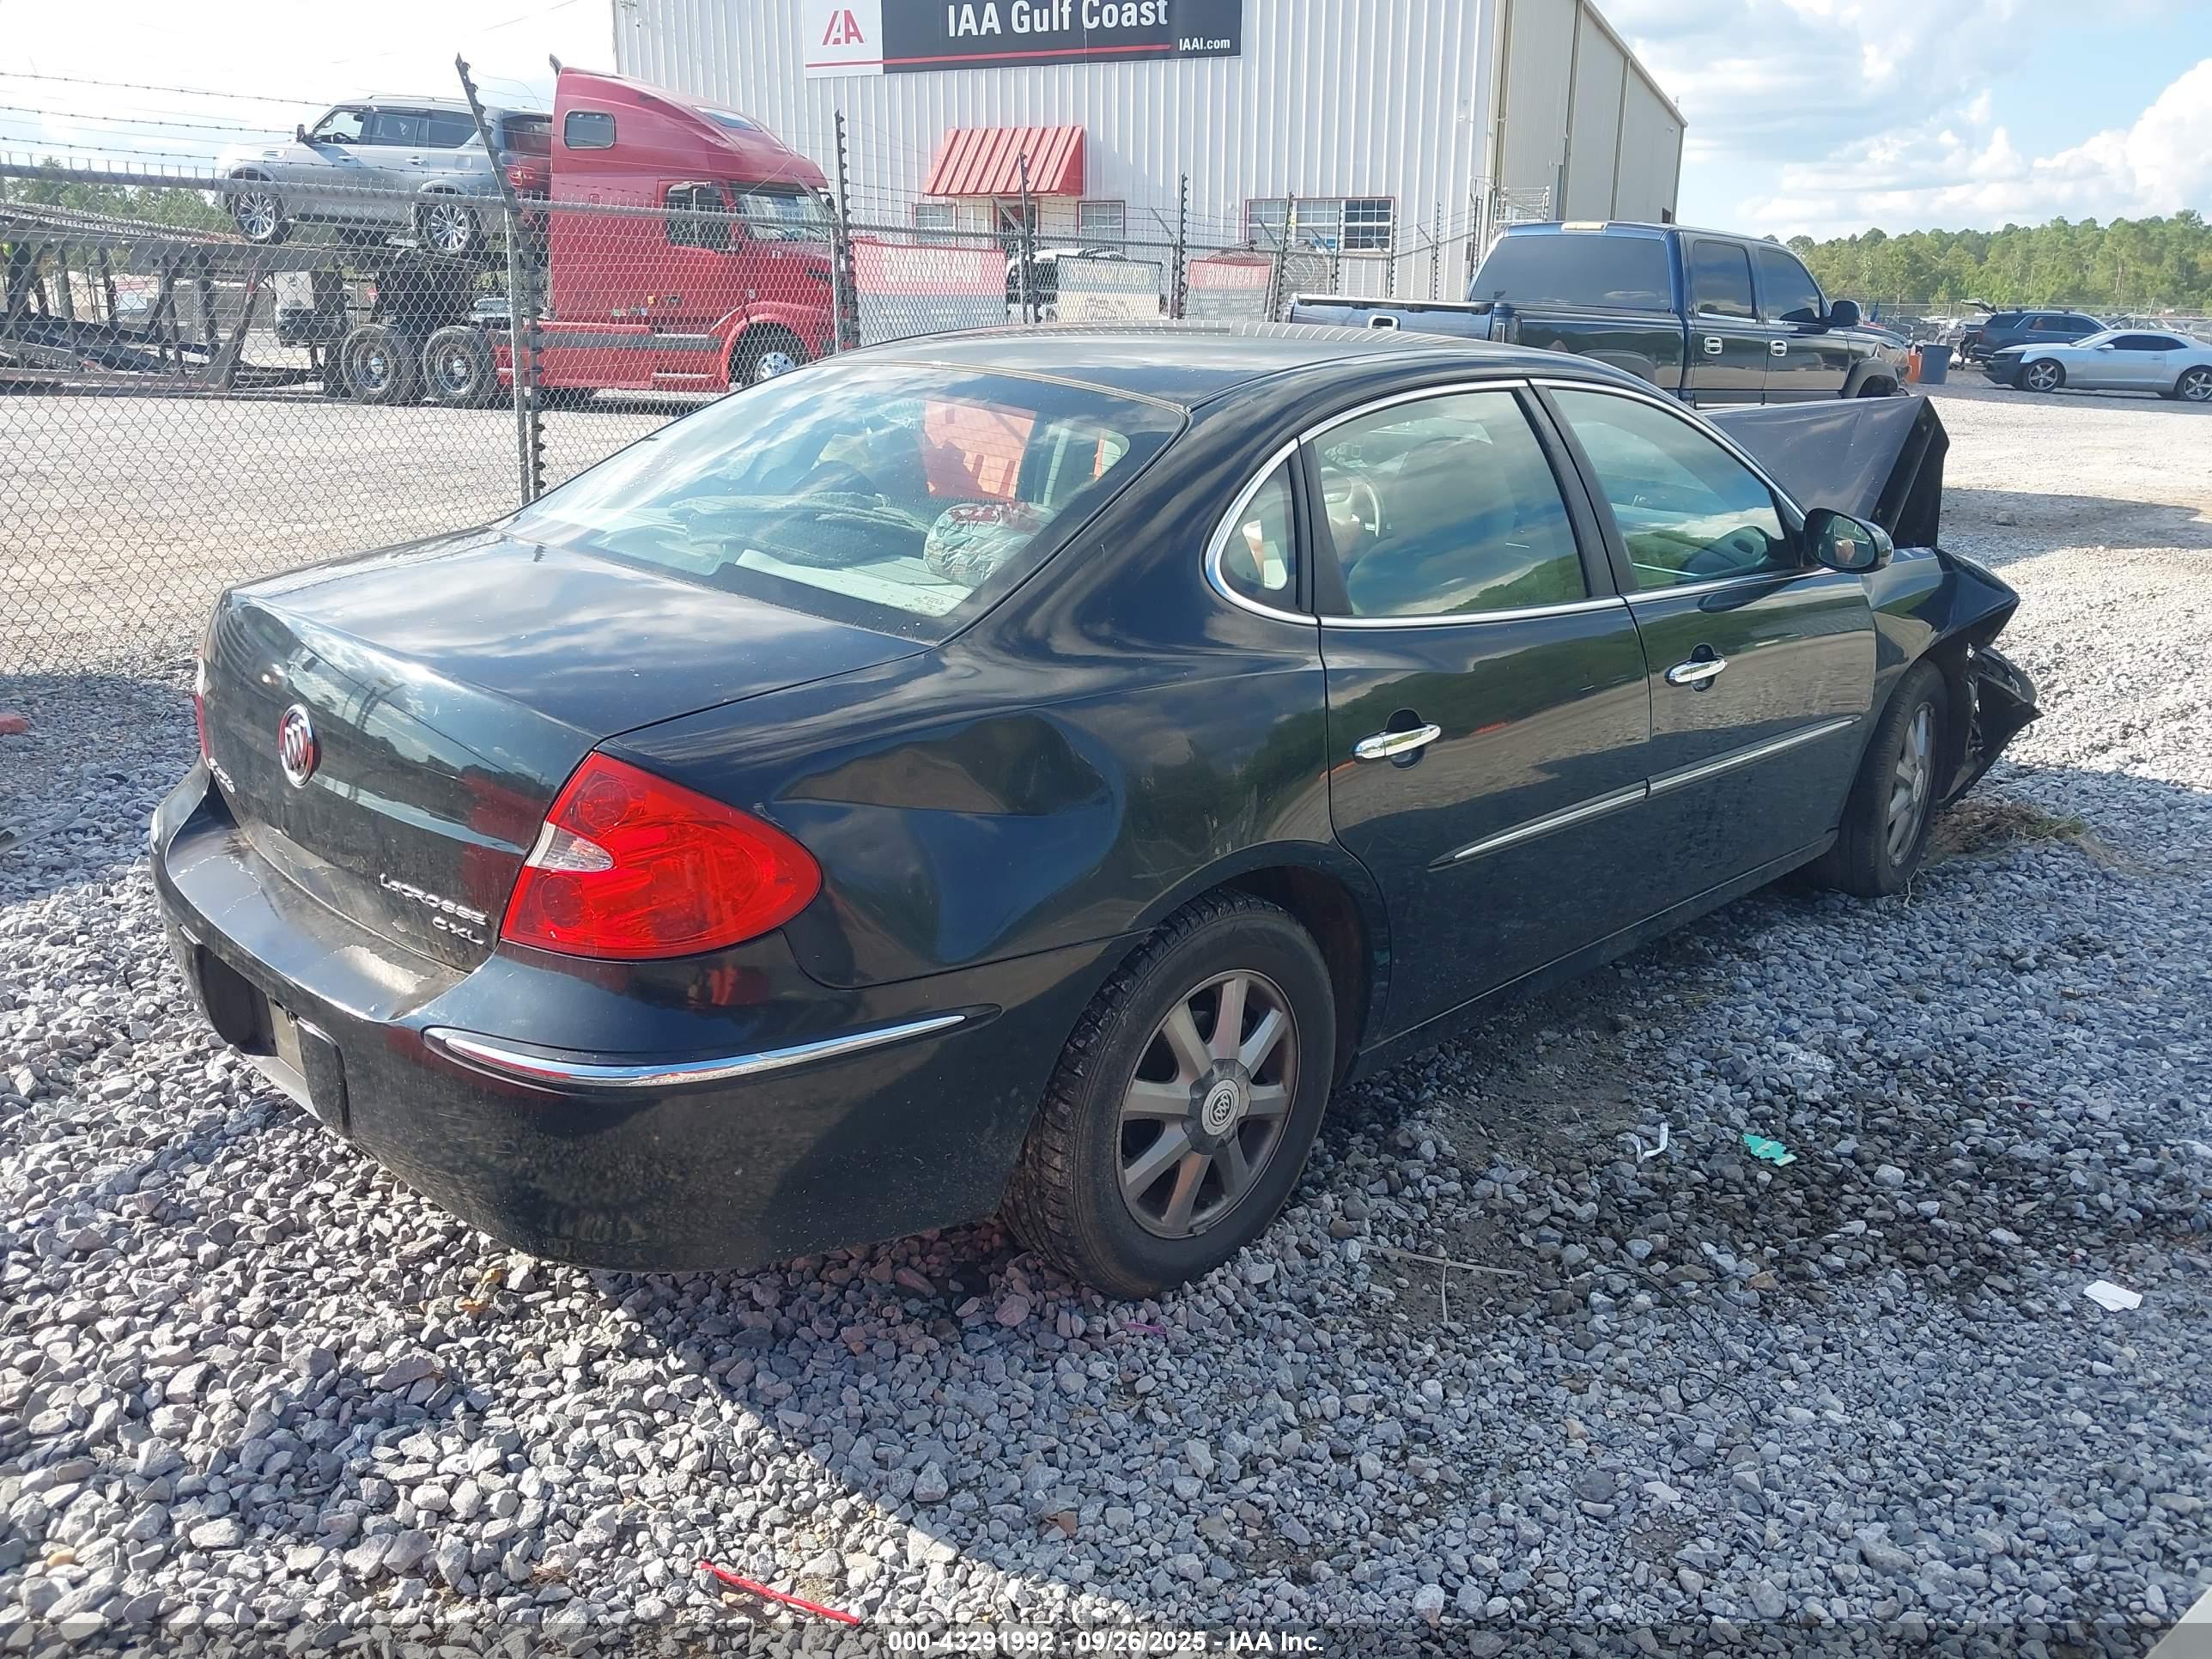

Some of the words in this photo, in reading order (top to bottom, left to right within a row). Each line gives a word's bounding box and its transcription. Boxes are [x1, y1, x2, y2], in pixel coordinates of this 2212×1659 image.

[948, 3, 1001, 37] IAA
[1011, 0, 1072, 33] Gulf
[1081, 0, 1168, 29] Coast
[1179, 37, 1231, 51] IAAI.com
[432, 915, 485, 945] CXL
